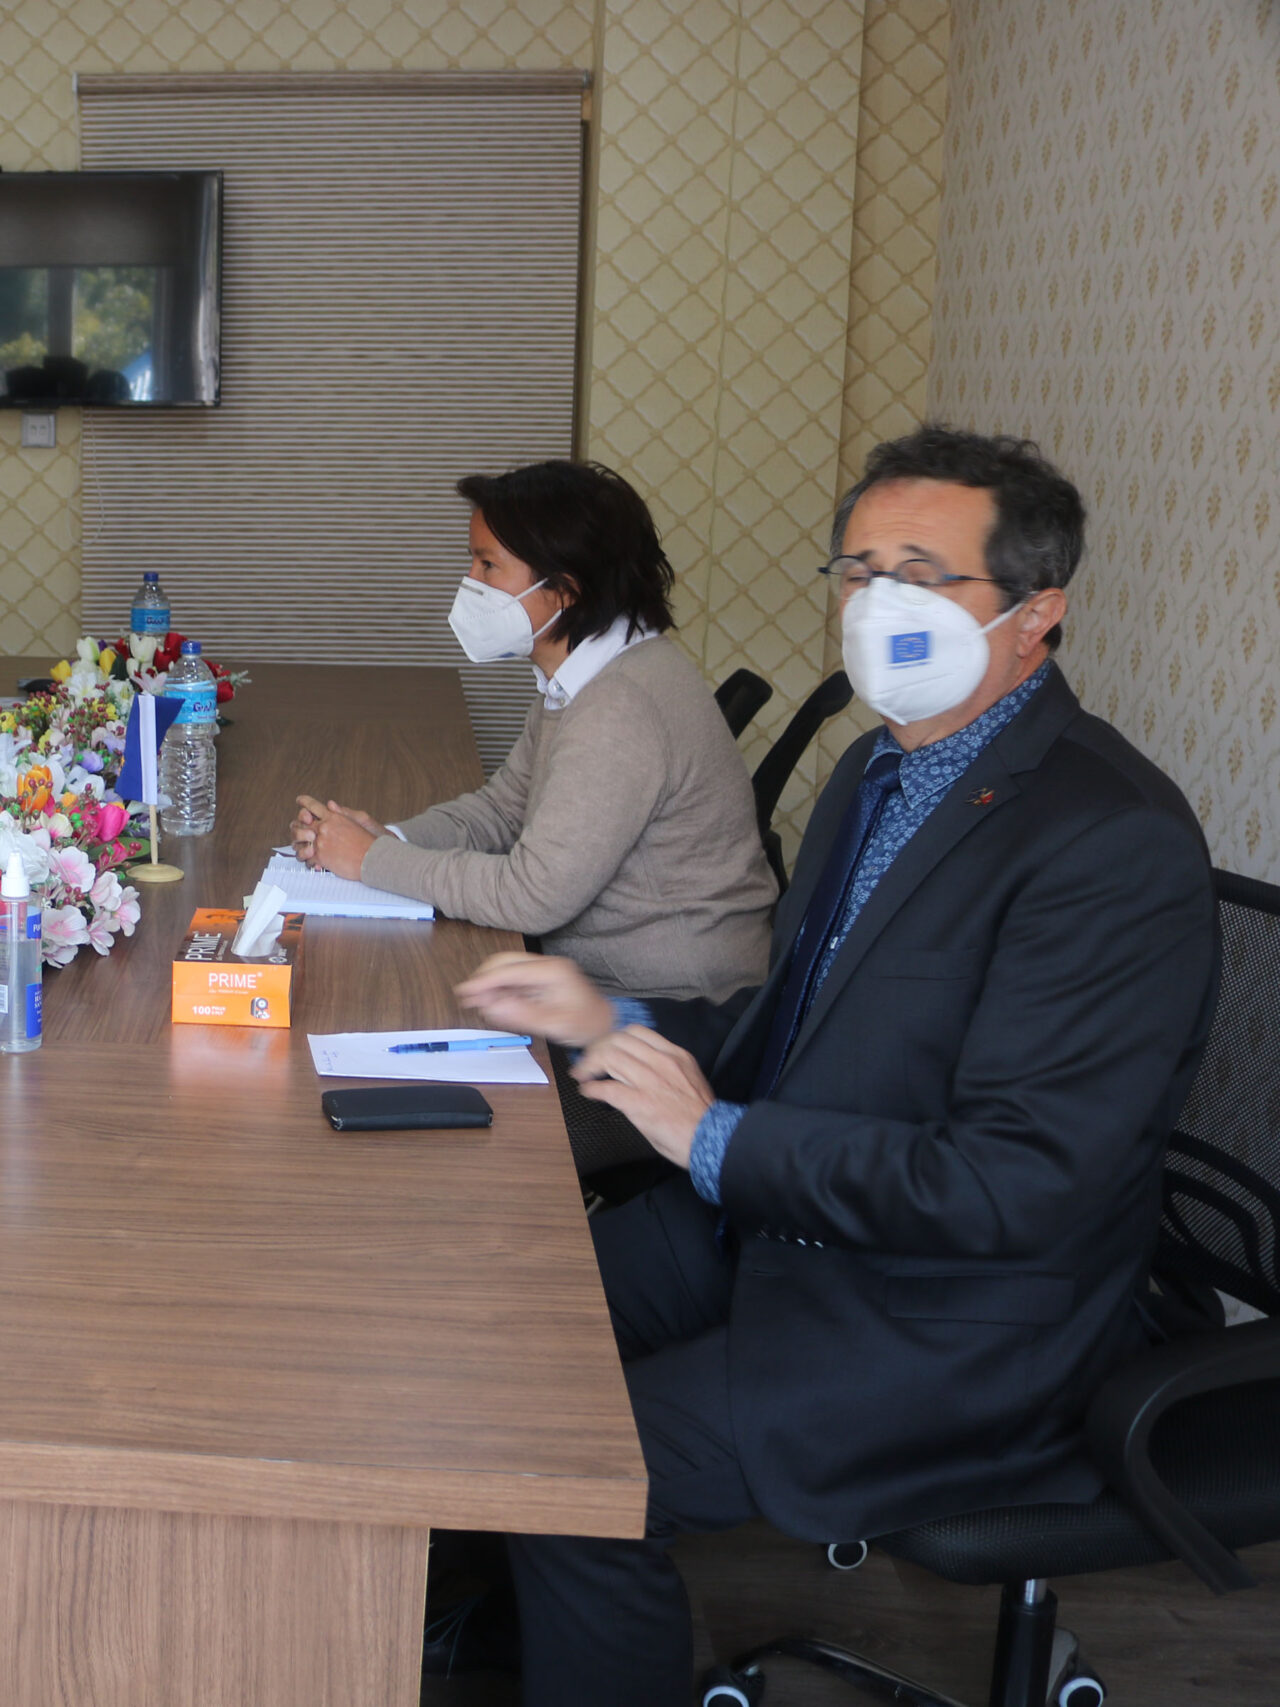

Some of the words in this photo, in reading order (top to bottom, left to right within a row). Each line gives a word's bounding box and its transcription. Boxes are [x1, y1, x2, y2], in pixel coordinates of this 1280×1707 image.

[185, 933, 221, 961] PRIME
[208, 972, 257, 990] PRIME
[192, 1006, 211, 1015] 100
